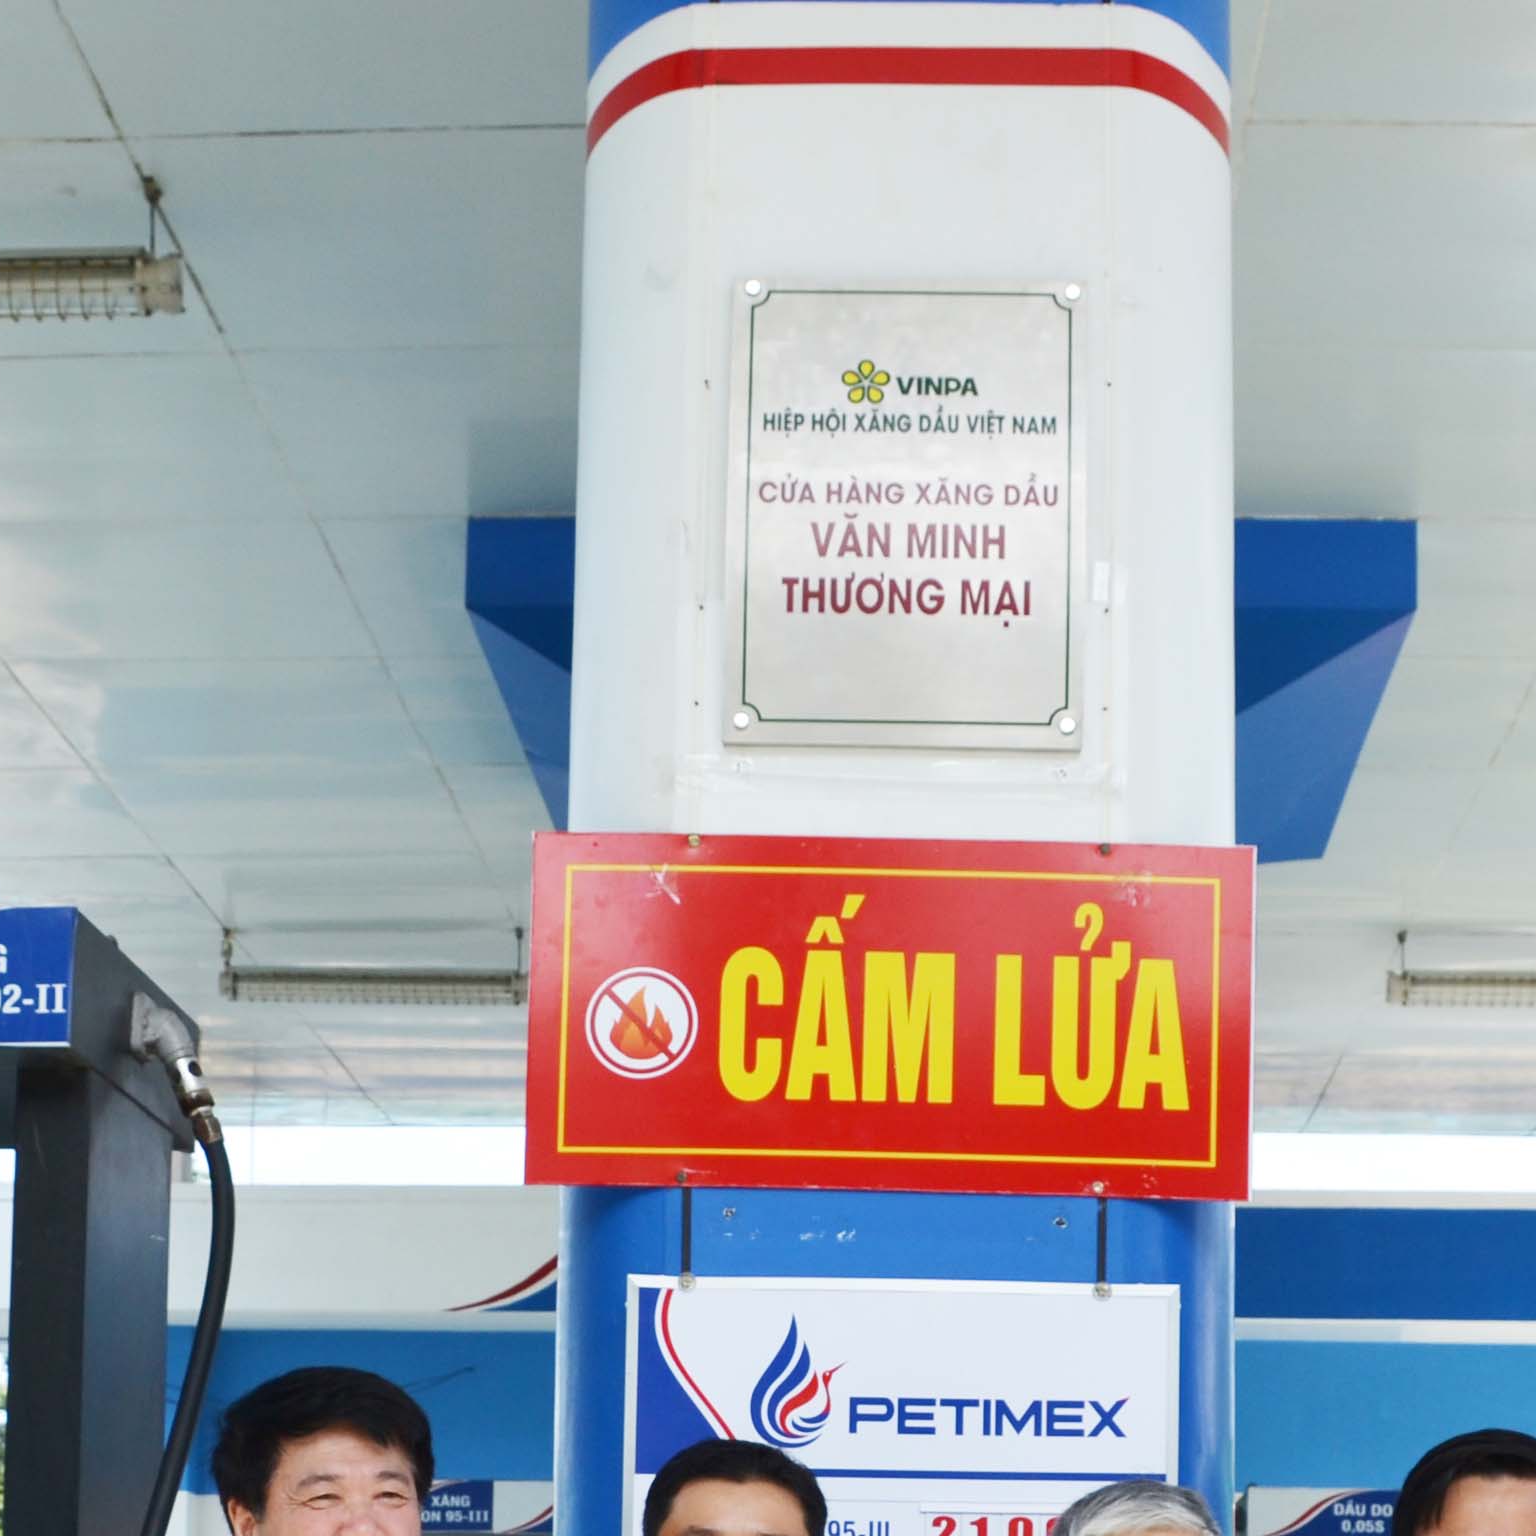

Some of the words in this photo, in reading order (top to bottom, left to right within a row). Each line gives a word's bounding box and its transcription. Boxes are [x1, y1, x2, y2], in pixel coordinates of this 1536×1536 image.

[895, 376, 979, 397] VINPA
[762, 408, 805, 438] HIỆP
[811, 408, 847, 438] HỘI
[853, 409, 912, 434] XĂNG
[966, 409, 1006, 440] VIỆT
[1011, 415, 1057, 435] NAM
[758, 472, 816, 505] CỬA
[825, 475, 905, 505] HÀNG
[915, 476, 995, 507] XĂNG
[810, 512, 892, 558] VĂN
[906, 522, 1006, 560] MINH
[781, 571, 946, 615] THƯƠNG
[960, 578, 1031, 628] MẠI
[718, 893, 956, 1104] CẤM
[993, 902, 1191, 1112] LỬA
[848, 1396, 1131, 1438] PETIMEX
[420, 1510, 441, 1523] ON
[1370, 1503, 1394, 1517] DO
